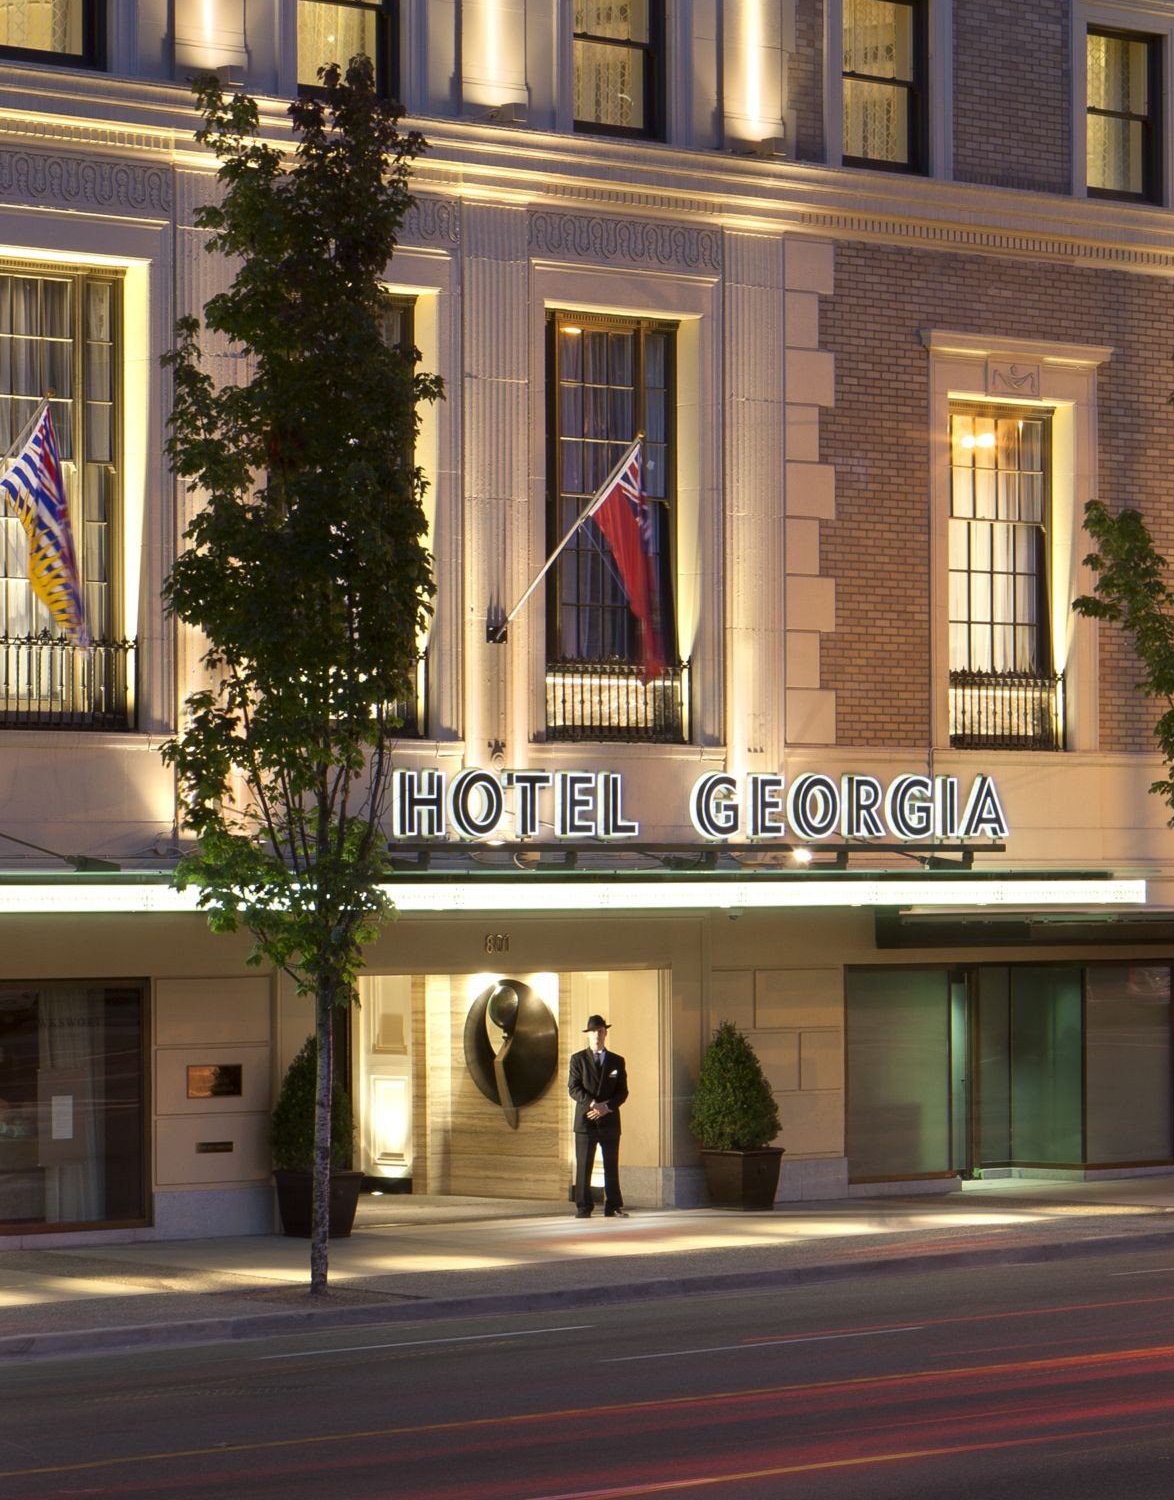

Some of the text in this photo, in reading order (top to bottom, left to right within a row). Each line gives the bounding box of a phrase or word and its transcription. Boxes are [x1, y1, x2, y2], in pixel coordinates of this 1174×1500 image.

[392, 768, 1010, 841] HOTEL GEORGIA
[484, 933, 510, 954] 801
